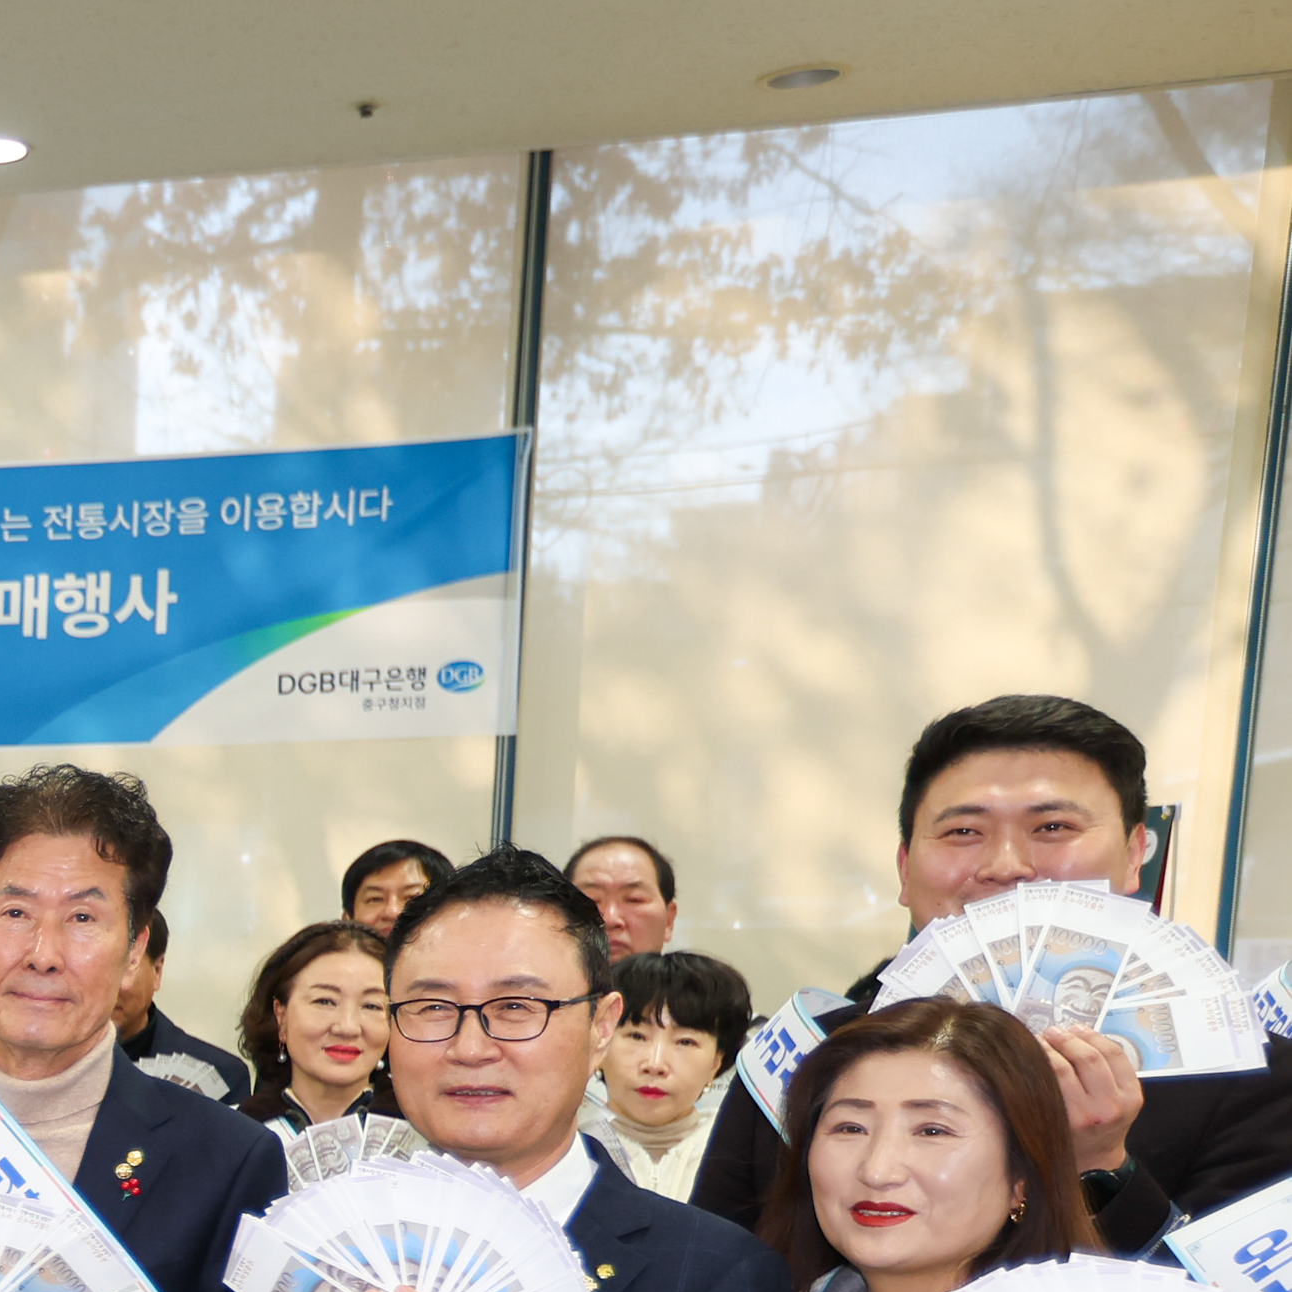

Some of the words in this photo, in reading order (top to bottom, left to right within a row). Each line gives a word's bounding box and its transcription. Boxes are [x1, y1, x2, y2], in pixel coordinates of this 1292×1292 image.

[43, 498, 210, 540] 전통시장을
[220, 486, 393, 532] 이용합시다
[278, 666, 427, 695] DGB대구은행
[362, 697, 426, 711] 중구청지점
[1052, 928, 1107, 956] 10000
[1153, 1004, 1177, 1054] 10000
